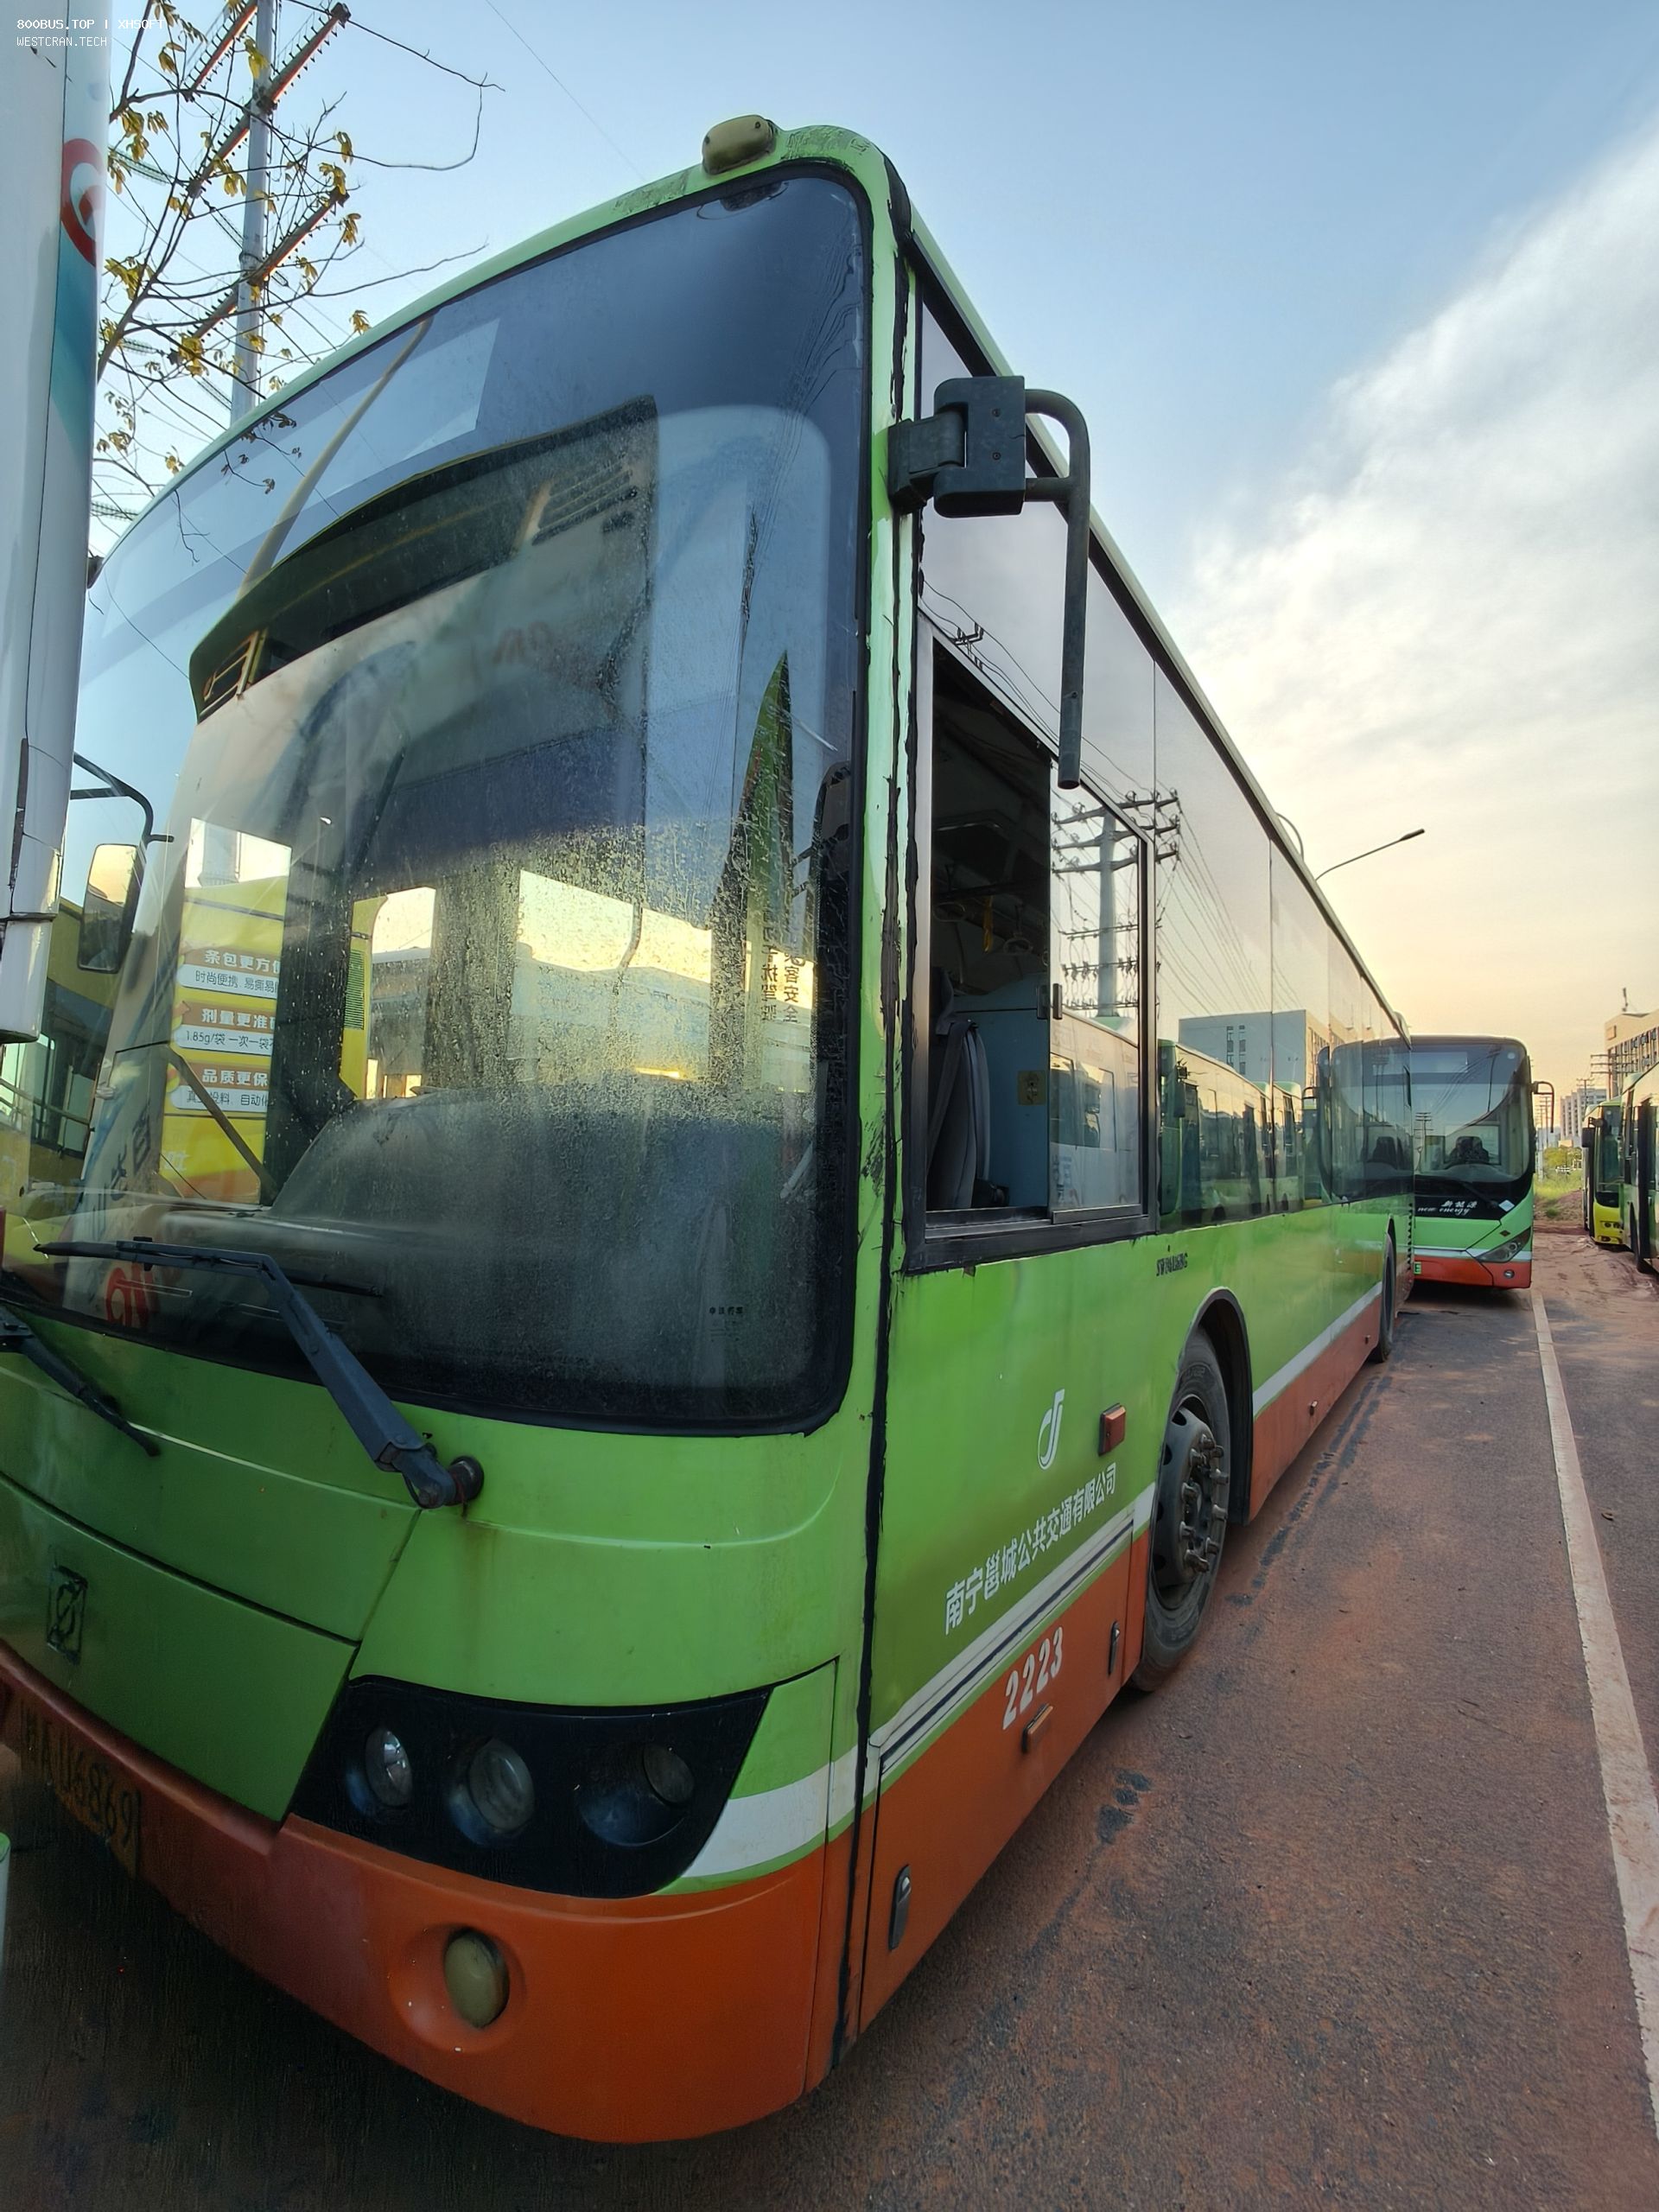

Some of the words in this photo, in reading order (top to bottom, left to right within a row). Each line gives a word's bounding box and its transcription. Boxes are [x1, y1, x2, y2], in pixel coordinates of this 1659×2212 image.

[944, 1461, 1117, 1636] 南宁邕城公共交通有限公司
[1001, 1626, 1064, 1731] 2223
